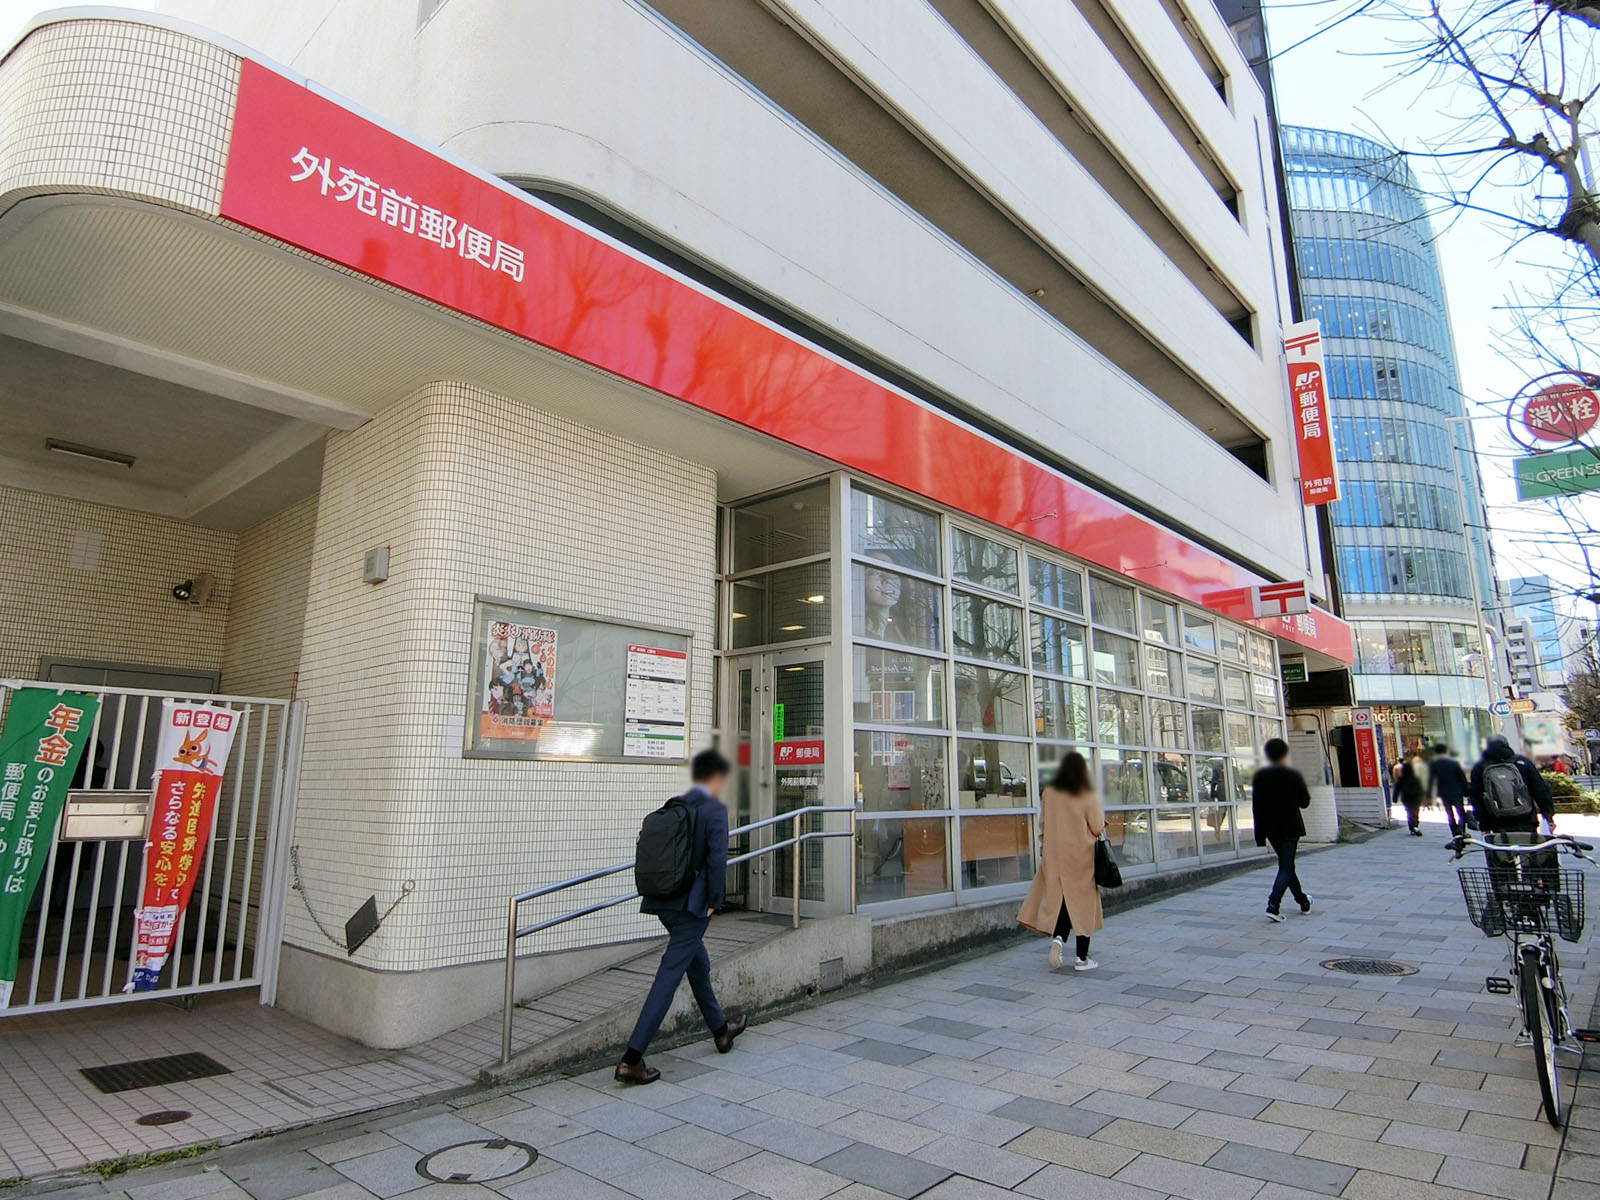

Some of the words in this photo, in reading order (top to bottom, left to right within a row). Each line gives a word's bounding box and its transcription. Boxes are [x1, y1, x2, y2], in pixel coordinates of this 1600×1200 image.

[290, 146, 525, 283] 外苑前郵便局
[1295, 370, 1320, 387] JP
[1299, 390, 1322, 440] 郵便局
[1528, 396, 1595, 430] 消火栓
[1303, 477, 1333, 489] 外苑前
[1536, 466, 1584, 483] GREEN
[546, 645, 555, 690] 火の用心
[1496, 704, 1509, 713] 418
[175, 711, 231, 731] 新登場
[796, 747, 819, 758] 郵便局
[4, 702, 84, 893] 年金のお受け取りは
